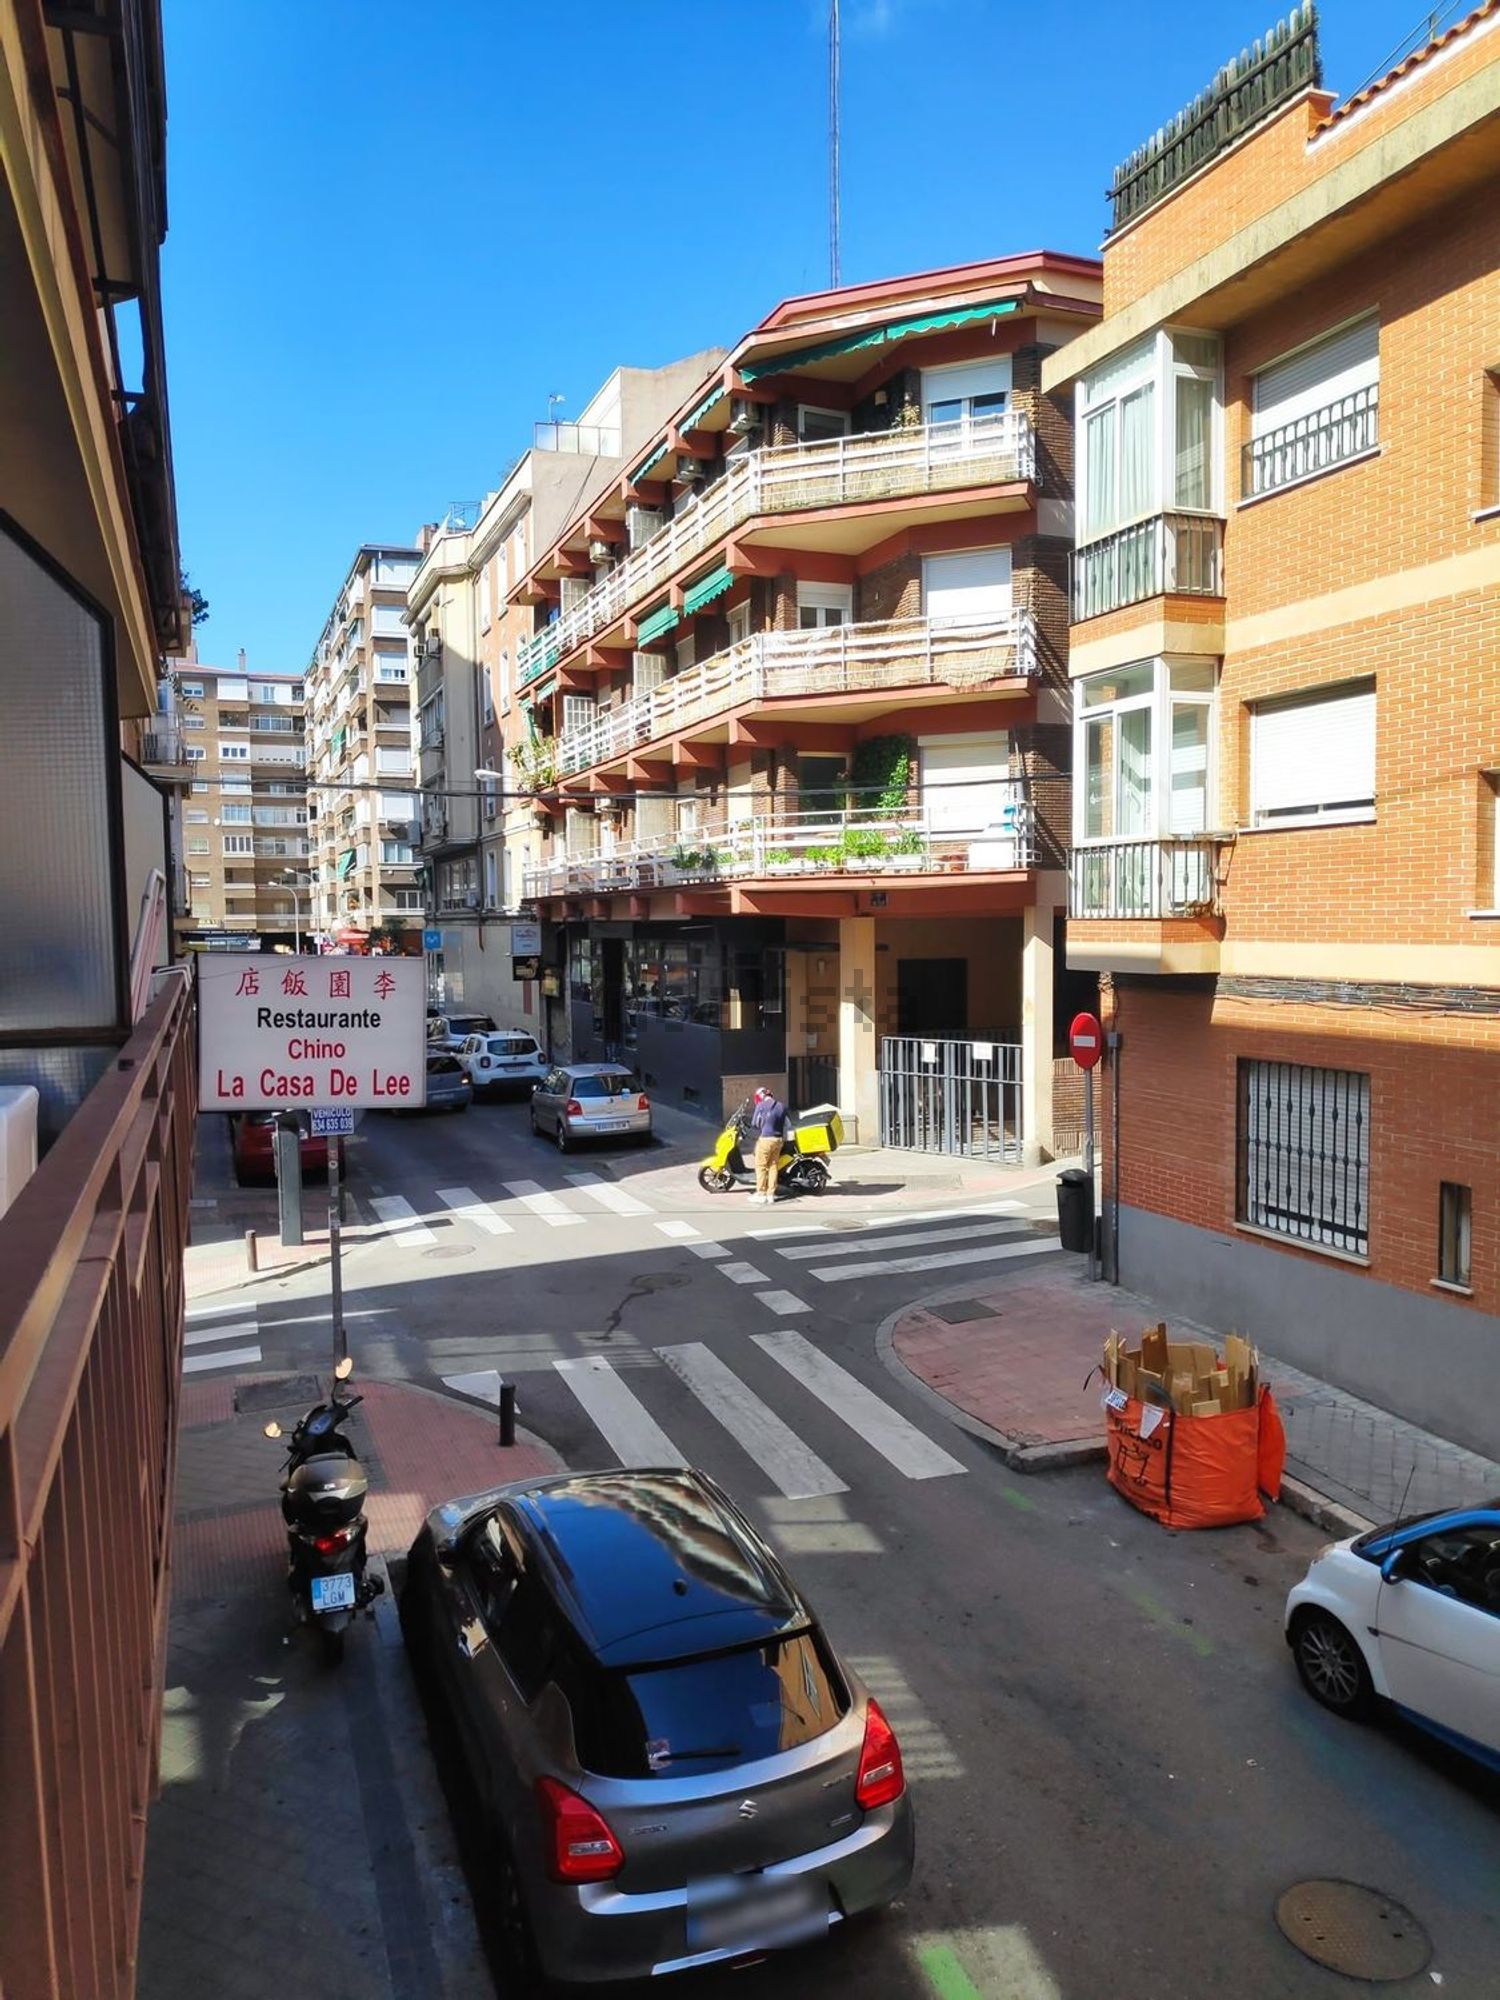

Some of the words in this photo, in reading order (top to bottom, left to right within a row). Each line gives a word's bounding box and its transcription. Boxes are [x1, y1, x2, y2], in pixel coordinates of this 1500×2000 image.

[257, 1007, 382, 1029] Restaurante
[288, 1039, 346, 1060] Chino
[217, 1069, 244, 1098] La
[260, 1068, 315, 1097] Casa
[330, 1069, 358, 1096] De
[373, 1068, 411, 1096] Lee
[322, 1575, 352, 1592] 3773
